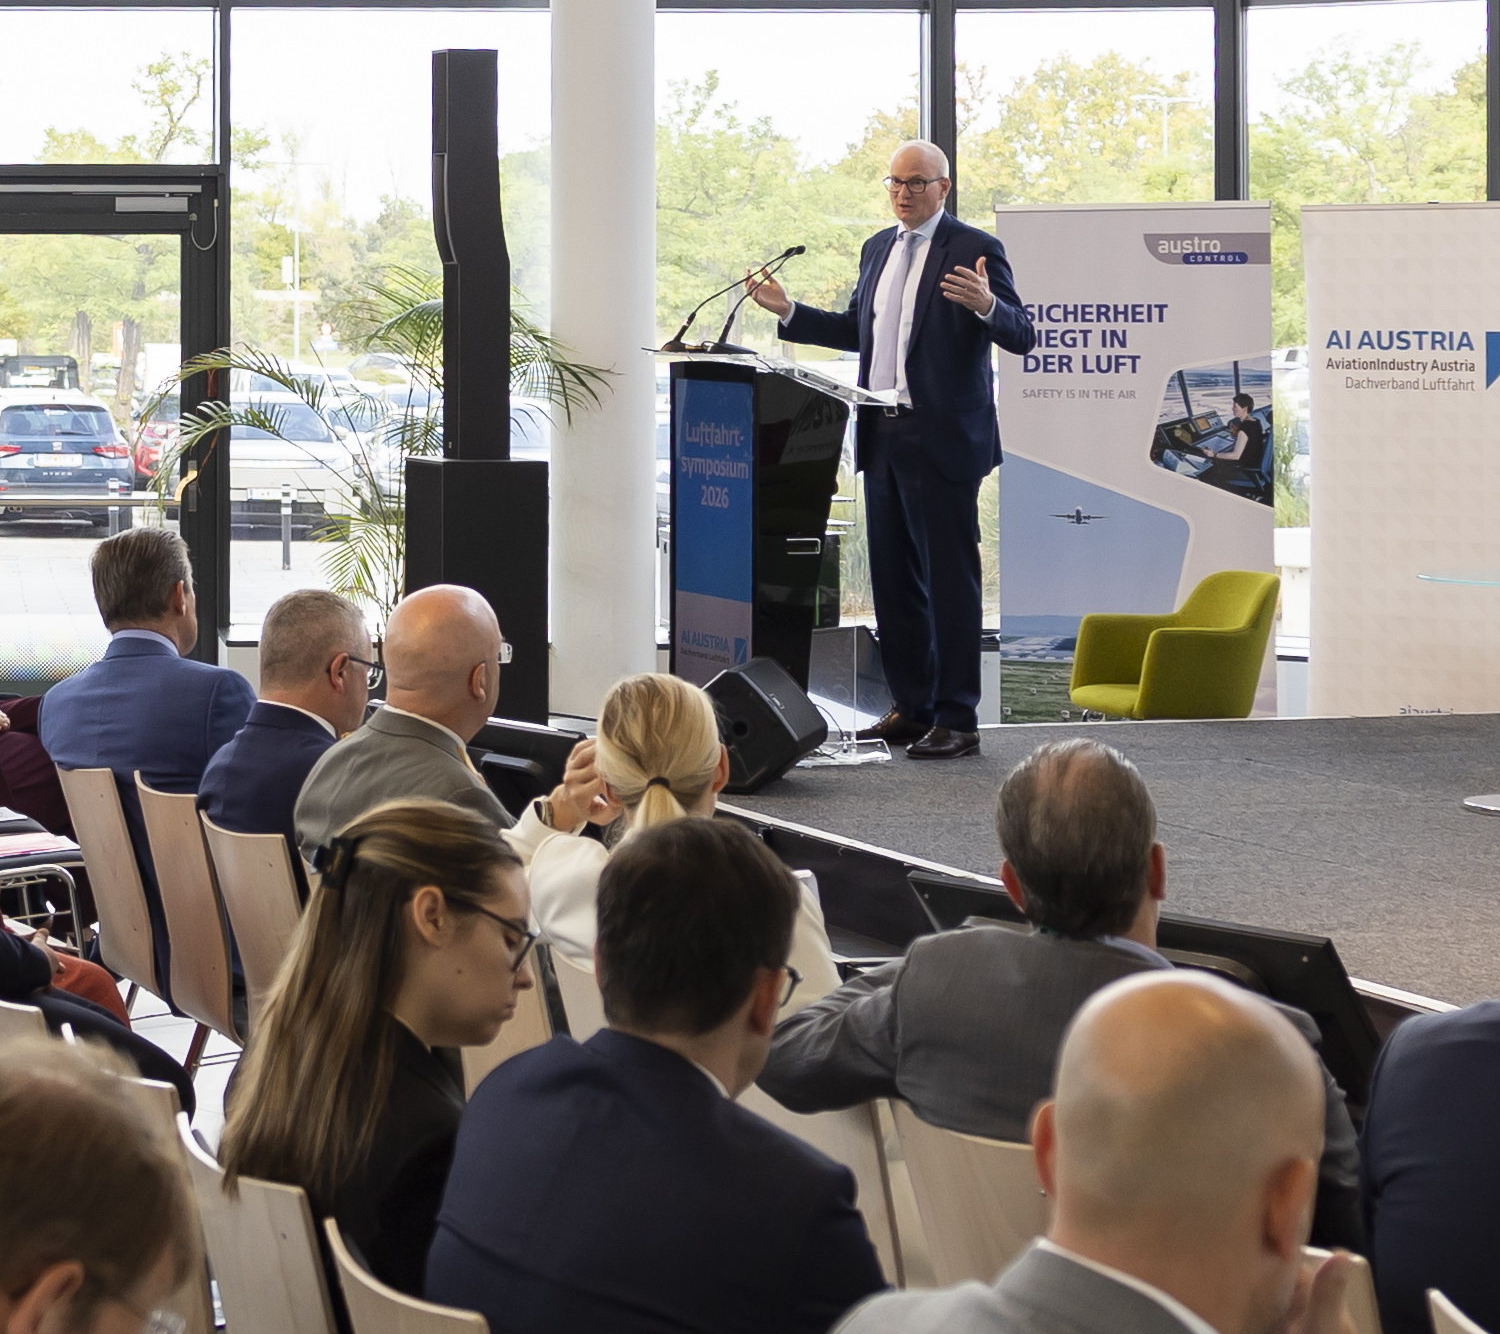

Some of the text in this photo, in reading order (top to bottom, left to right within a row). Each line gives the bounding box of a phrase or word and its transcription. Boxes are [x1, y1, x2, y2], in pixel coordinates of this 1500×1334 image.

[1158, 236, 1221, 254] austro
[1189, 255, 1241, 263] CONTROL
[1025, 304, 1168, 323] SICHERHEIT
[1037, 329, 1126, 348] IEGT IN
[1326, 330, 1474, 351] AI AUSTRIA
[1023, 355, 1140, 373] DER LUFT
[1326, 358, 1475, 374] AviationIndustry Austria
[1346, 377, 1475, 391] Dachverband Luftfahrt
[1023, 389, 1136, 399] SAFETY IS IN THE AIR
[686, 422, 744, 447] Luftfahrt-
[680, 453, 748, 480] symposium
[701, 486, 729, 508] 2026
